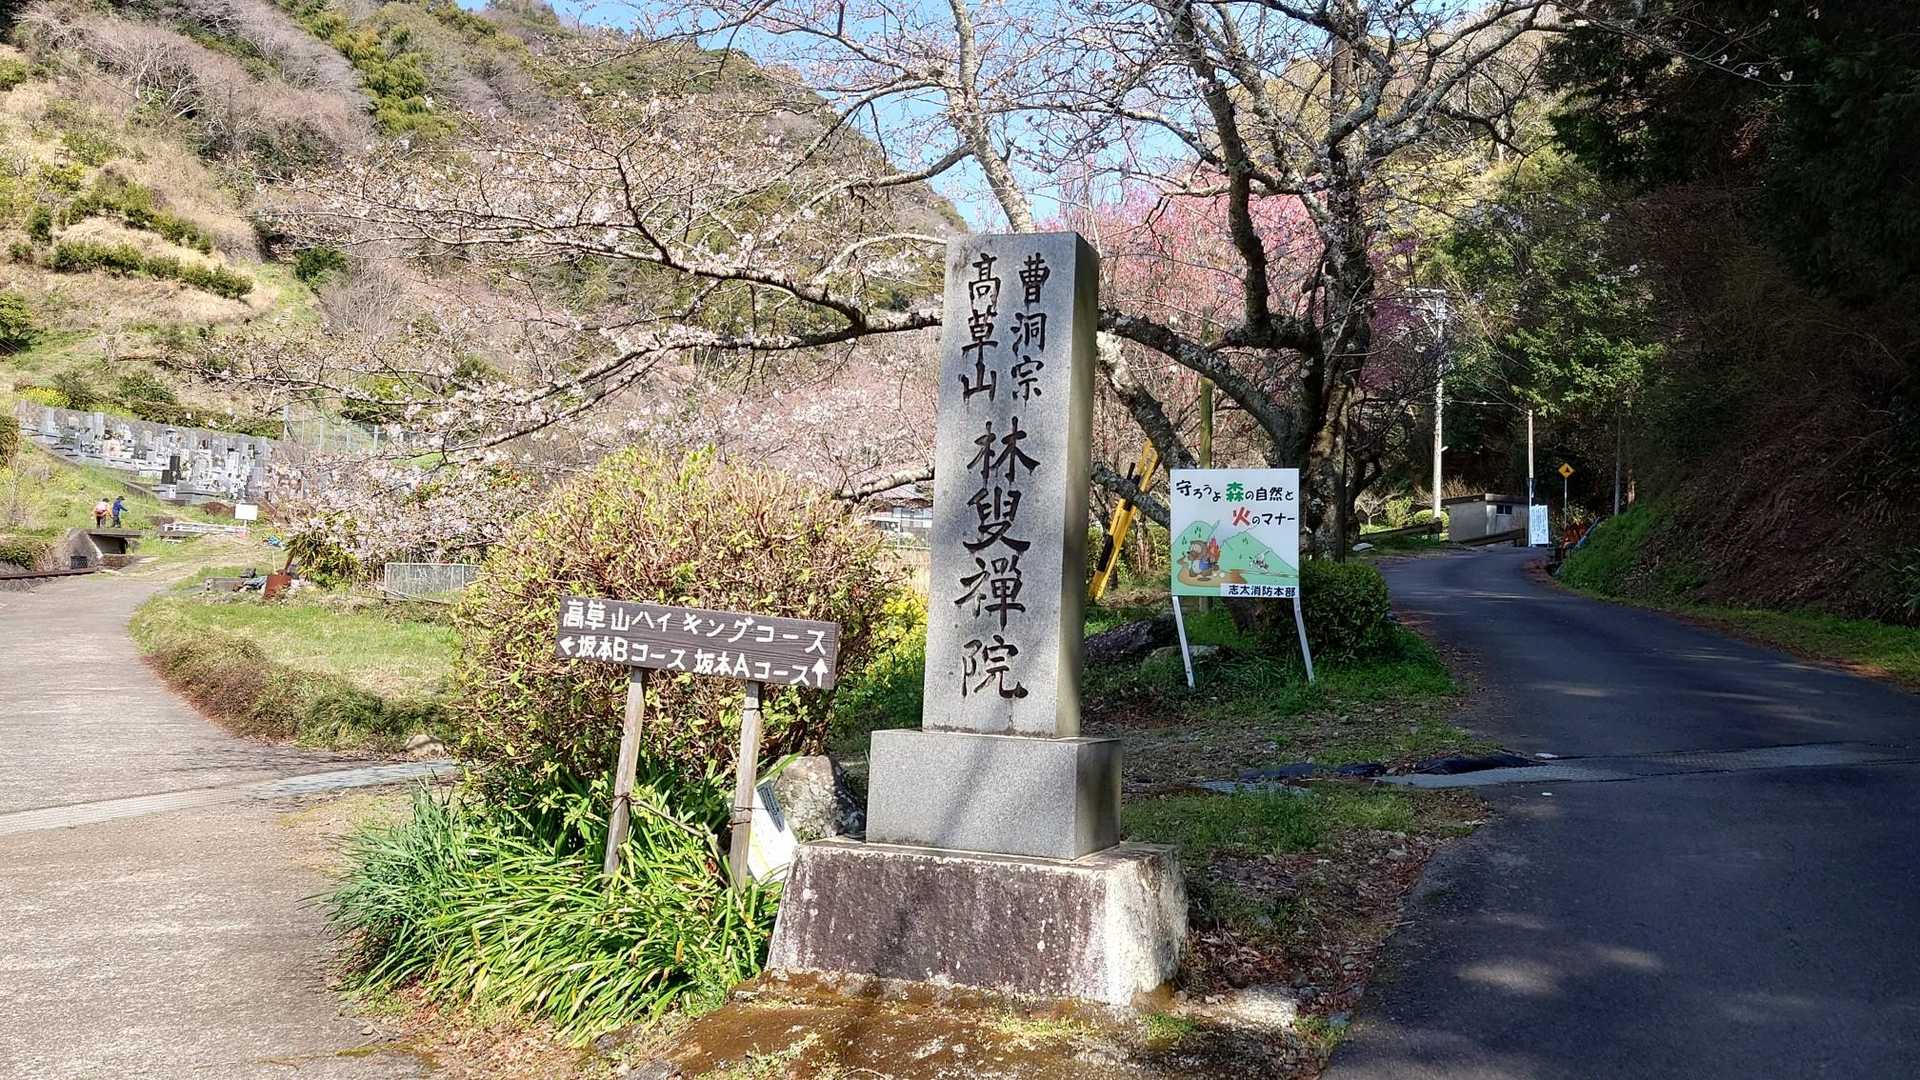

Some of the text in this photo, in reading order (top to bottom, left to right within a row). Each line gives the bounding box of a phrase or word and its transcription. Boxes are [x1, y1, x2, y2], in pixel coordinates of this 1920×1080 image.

[1010, 252, 1050, 401] 曹洞宗
[1232, 506, 1296, 526] 火のマナー
[1228, 584, 1296, 597] 志太消防本部
[575, 635, 811, 687] 坂本Bコース 坂本Aコース
